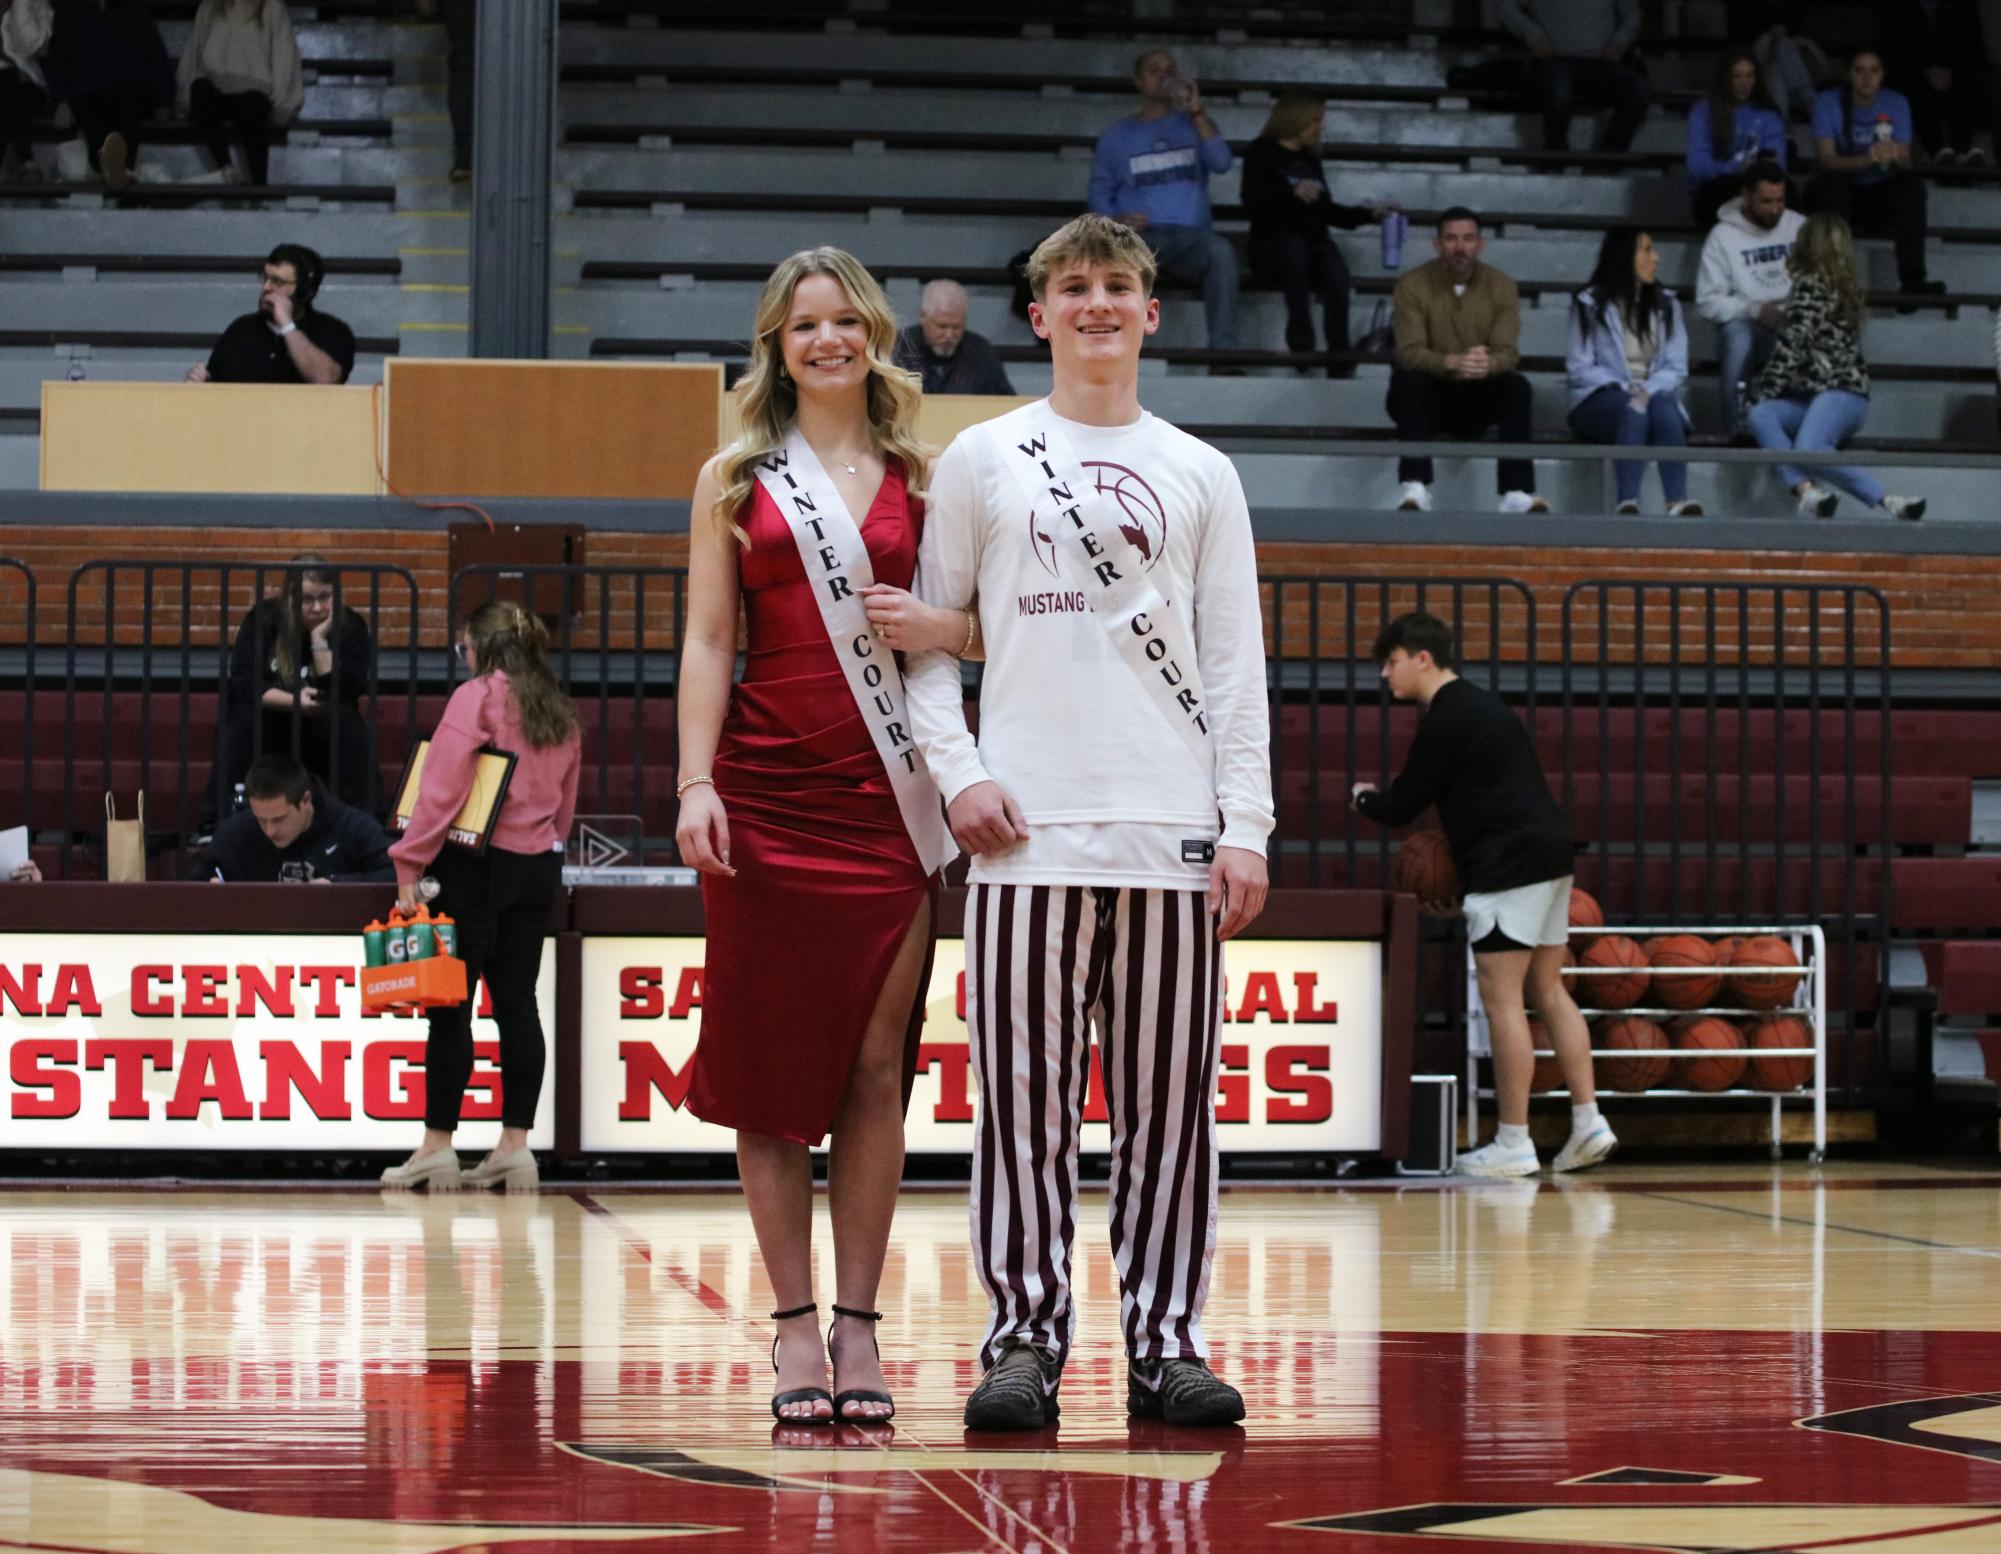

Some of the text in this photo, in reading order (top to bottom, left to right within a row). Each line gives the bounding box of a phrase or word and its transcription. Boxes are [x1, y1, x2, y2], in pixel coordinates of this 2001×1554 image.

[1741, 242, 1795, 266] TIGER
[1018, 432, 1208, 736] WINTER COURT
[761, 449, 916, 774] WINTER COURT
[1018, 591, 1085, 616] MUSTANG
[388, 938, 405, 959] G
[367, 976, 417, 995] GATORADE
